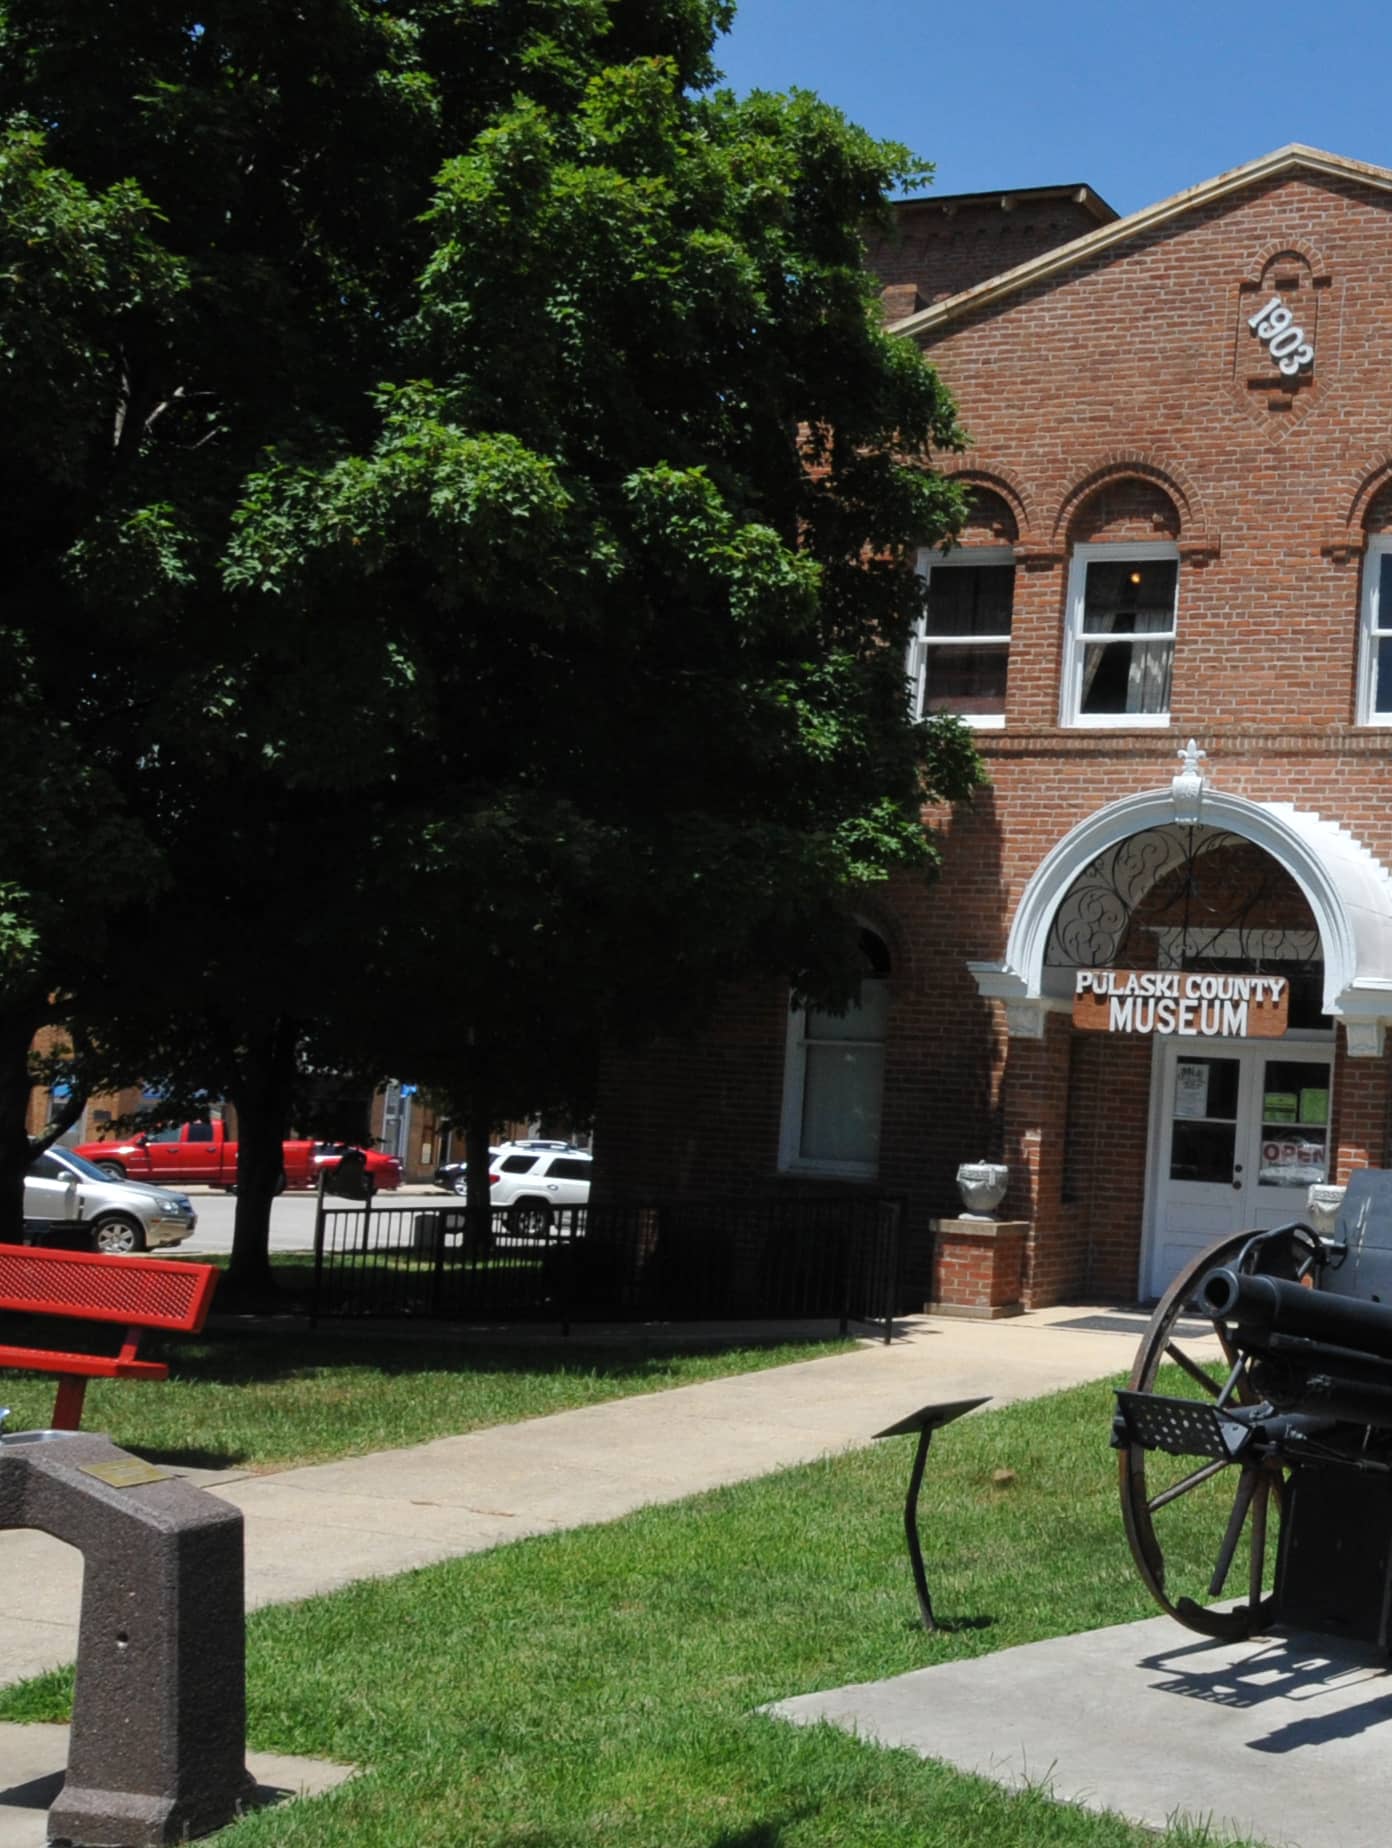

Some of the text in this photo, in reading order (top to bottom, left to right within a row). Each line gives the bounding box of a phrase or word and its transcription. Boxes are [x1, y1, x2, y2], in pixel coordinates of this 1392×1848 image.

[1248, 297, 1314, 375] 1903
[1076, 971, 1287, 1002] PULASKI COUNTY
[1109, 996, 1248, 1037] MUSEUM
[1263, 1143, 1326, 1164] OPEN
